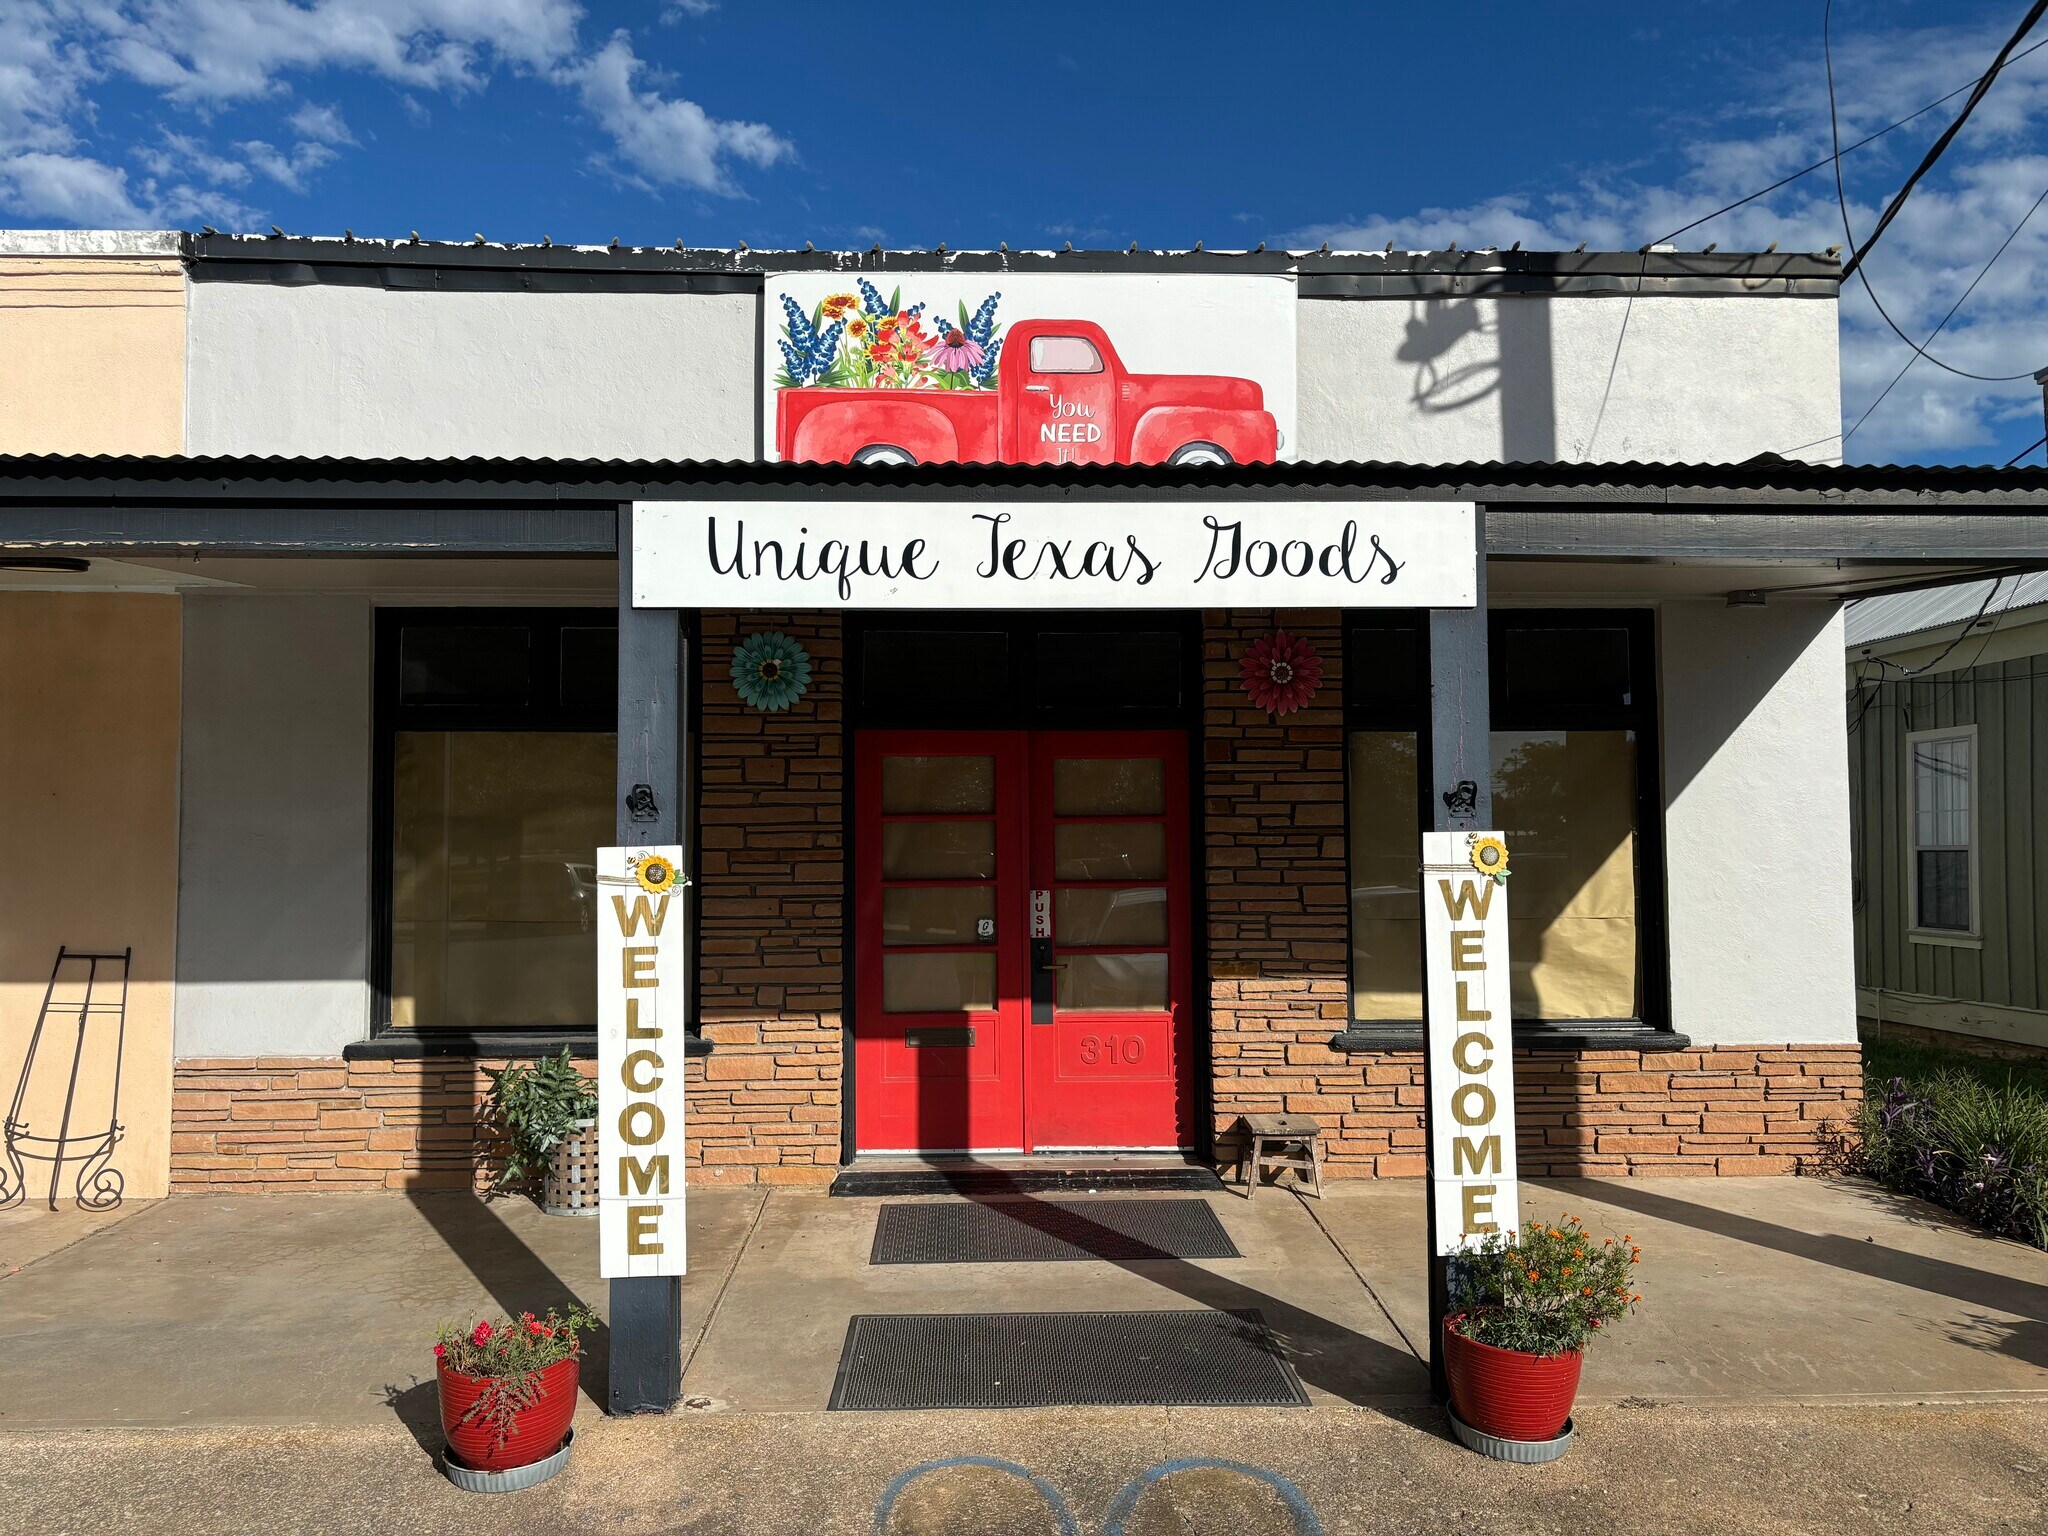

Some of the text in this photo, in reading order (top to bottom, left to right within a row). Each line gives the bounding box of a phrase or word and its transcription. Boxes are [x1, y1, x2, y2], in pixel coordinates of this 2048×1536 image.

[1049, 394, 1096, 419] You
[1040, 423, 1102, 443] NEED
[708, 512, 1406, 601] Unique Texas Goods
[1035, 890, 1045, 937] PUSH
[1080, 1034, 1146, 1065] 310
[1437, 879, 1503, 1235] WELCOME
[611, 894, 671, 1256] WELCOME
